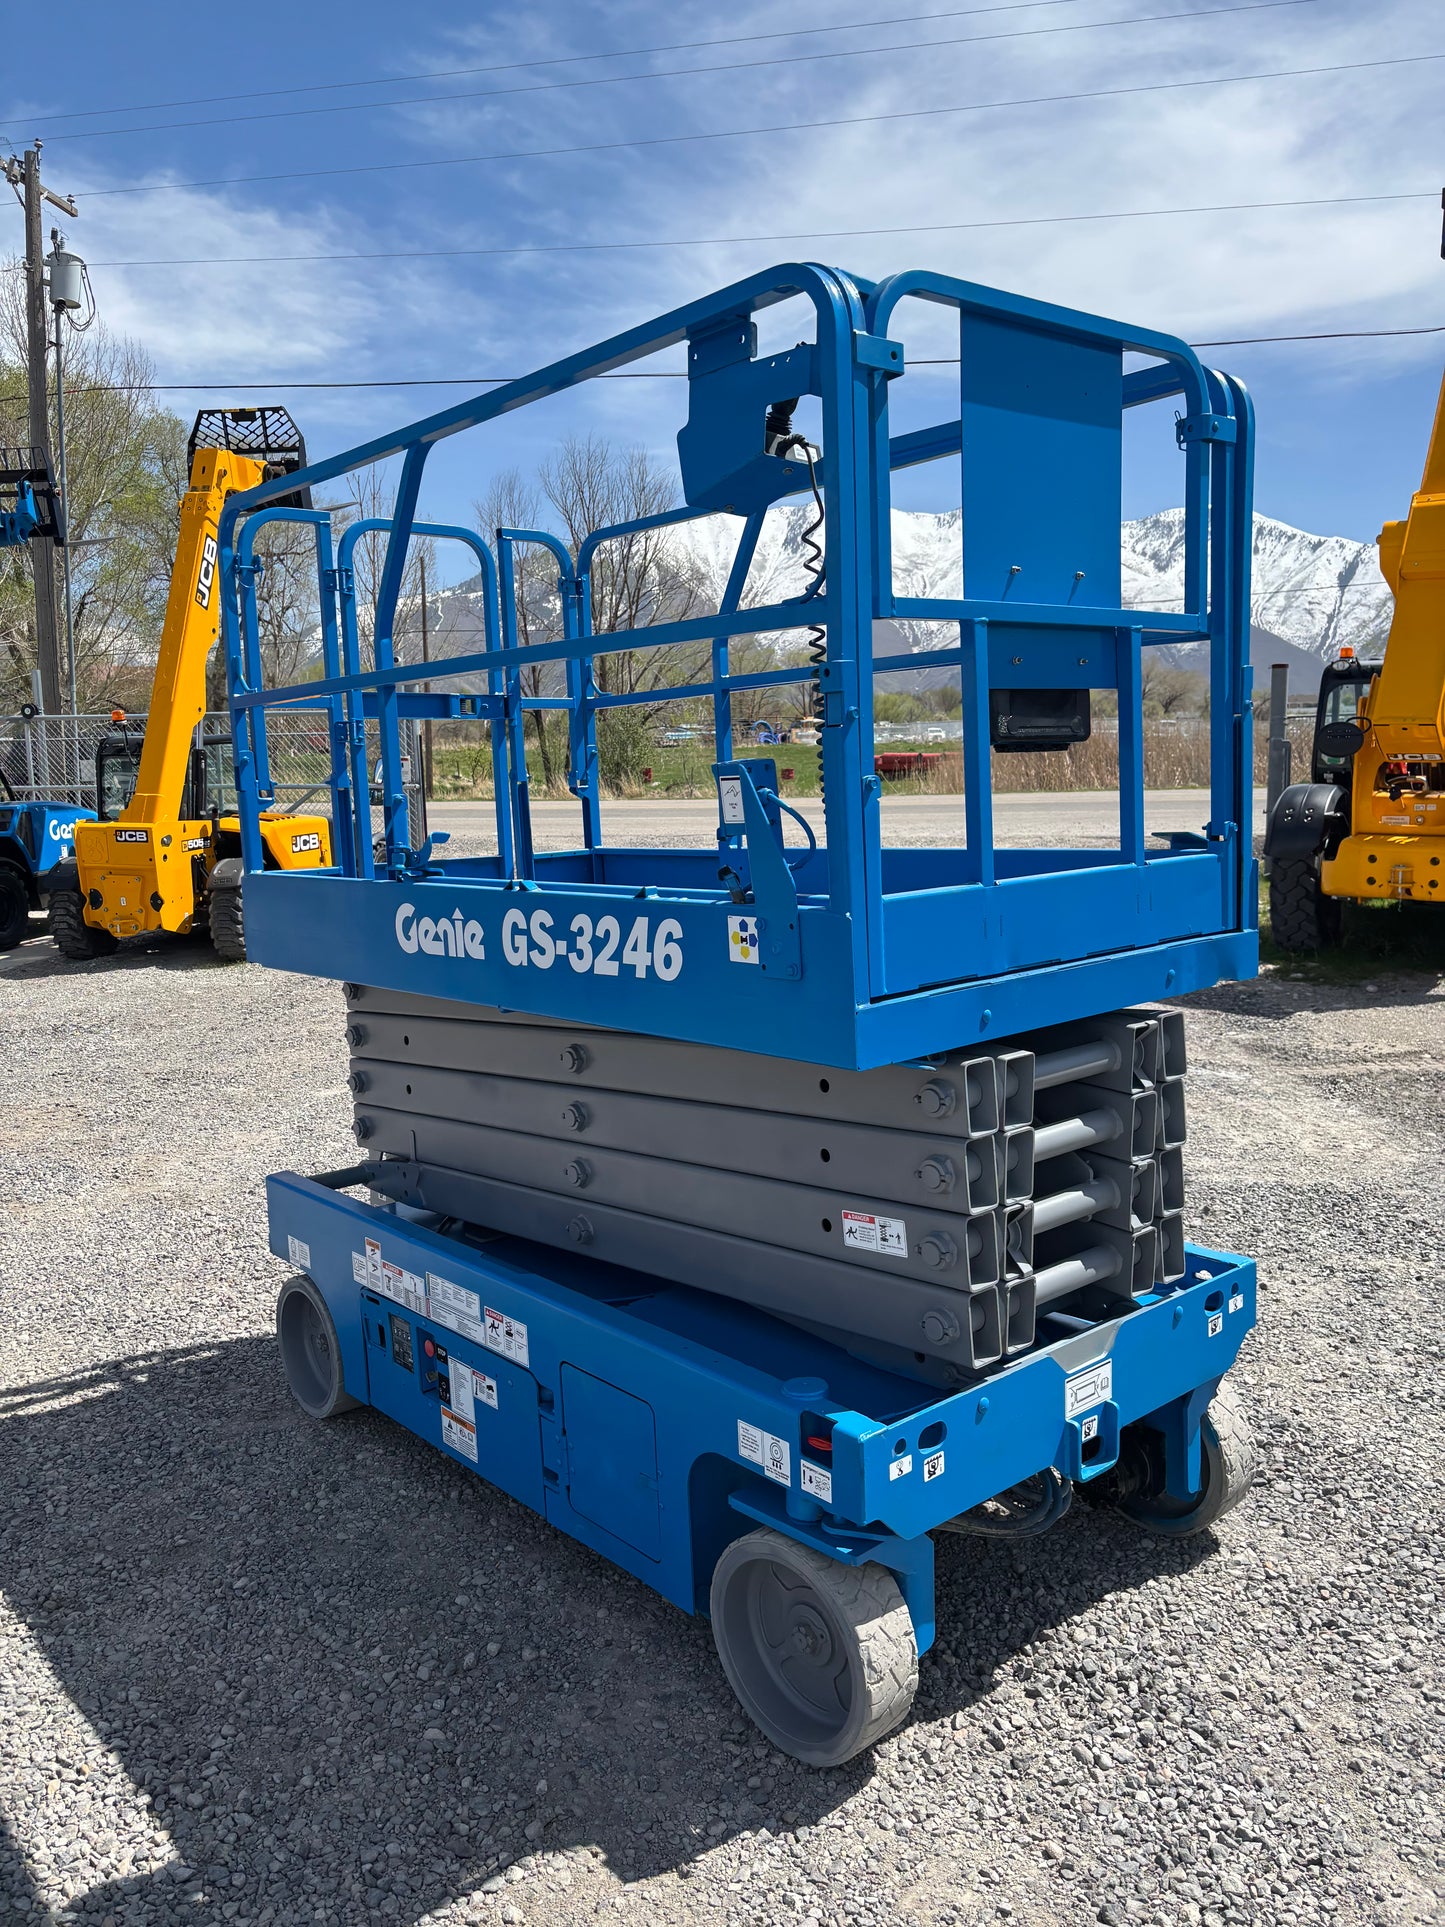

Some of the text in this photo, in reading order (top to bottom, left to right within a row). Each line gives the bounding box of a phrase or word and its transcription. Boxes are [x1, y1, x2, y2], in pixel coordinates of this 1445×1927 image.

[198, 536, 218, 607] JCB
[1388, 753, 1442, 761] JCB
[49, 818, 79, 841] Gen
[116, 831, 148, 842] JCB
[292, 833, 319, 852] JCB
[395, 902, 684, 982] Genie GS-3246
